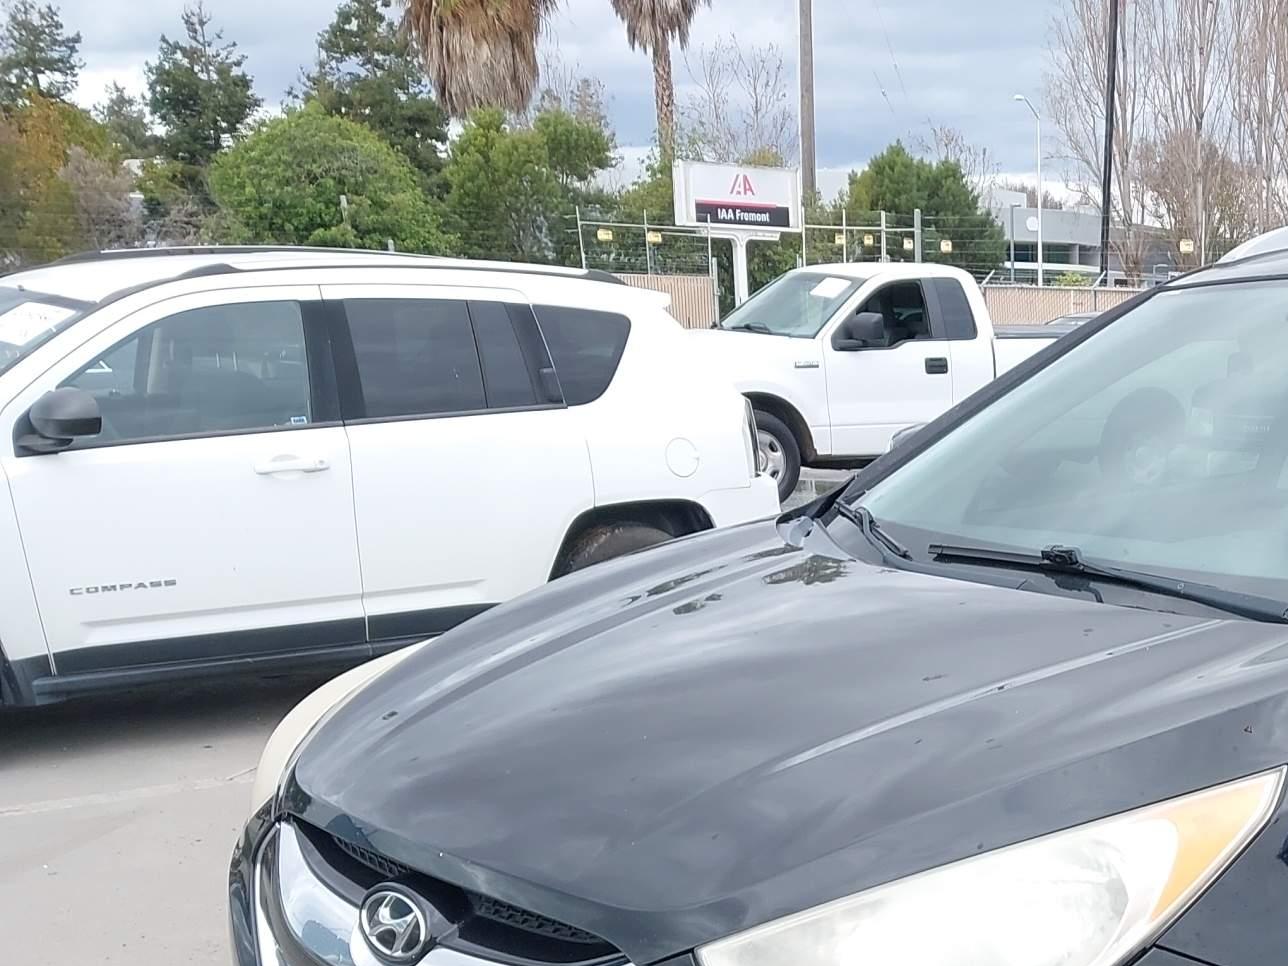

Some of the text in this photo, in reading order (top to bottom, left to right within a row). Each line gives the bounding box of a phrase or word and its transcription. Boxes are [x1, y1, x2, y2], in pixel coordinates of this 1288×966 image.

[717, 208, 770, 222] IAA Fremont
[70, 579, 177, 595] COMPASS
